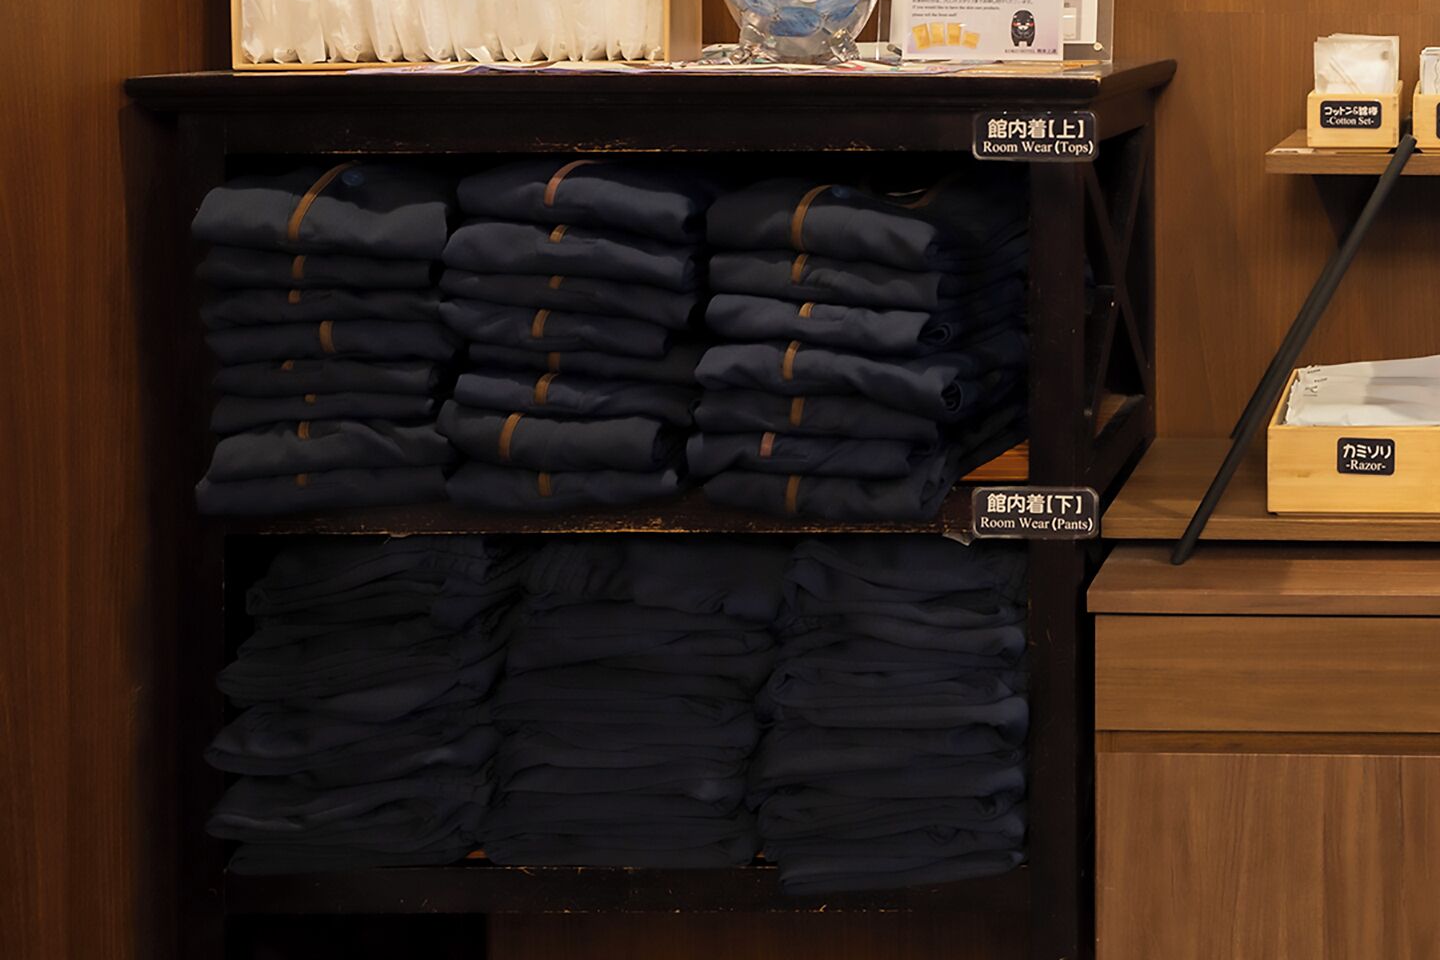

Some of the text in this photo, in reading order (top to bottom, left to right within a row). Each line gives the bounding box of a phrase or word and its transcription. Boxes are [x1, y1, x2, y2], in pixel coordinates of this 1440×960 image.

[988, 118, 1085, 139] 館内着【上】
[983, 140, 1094, 155] Room Wear (Tops)
[1342, 442, 1392, 458] カミソリ
[1345, 460, 1386, 471] -Razor-
[987, 493, 1082, 514] 館内着【下】
[981, 517, 1093, 531] Room Wear (Pants)
